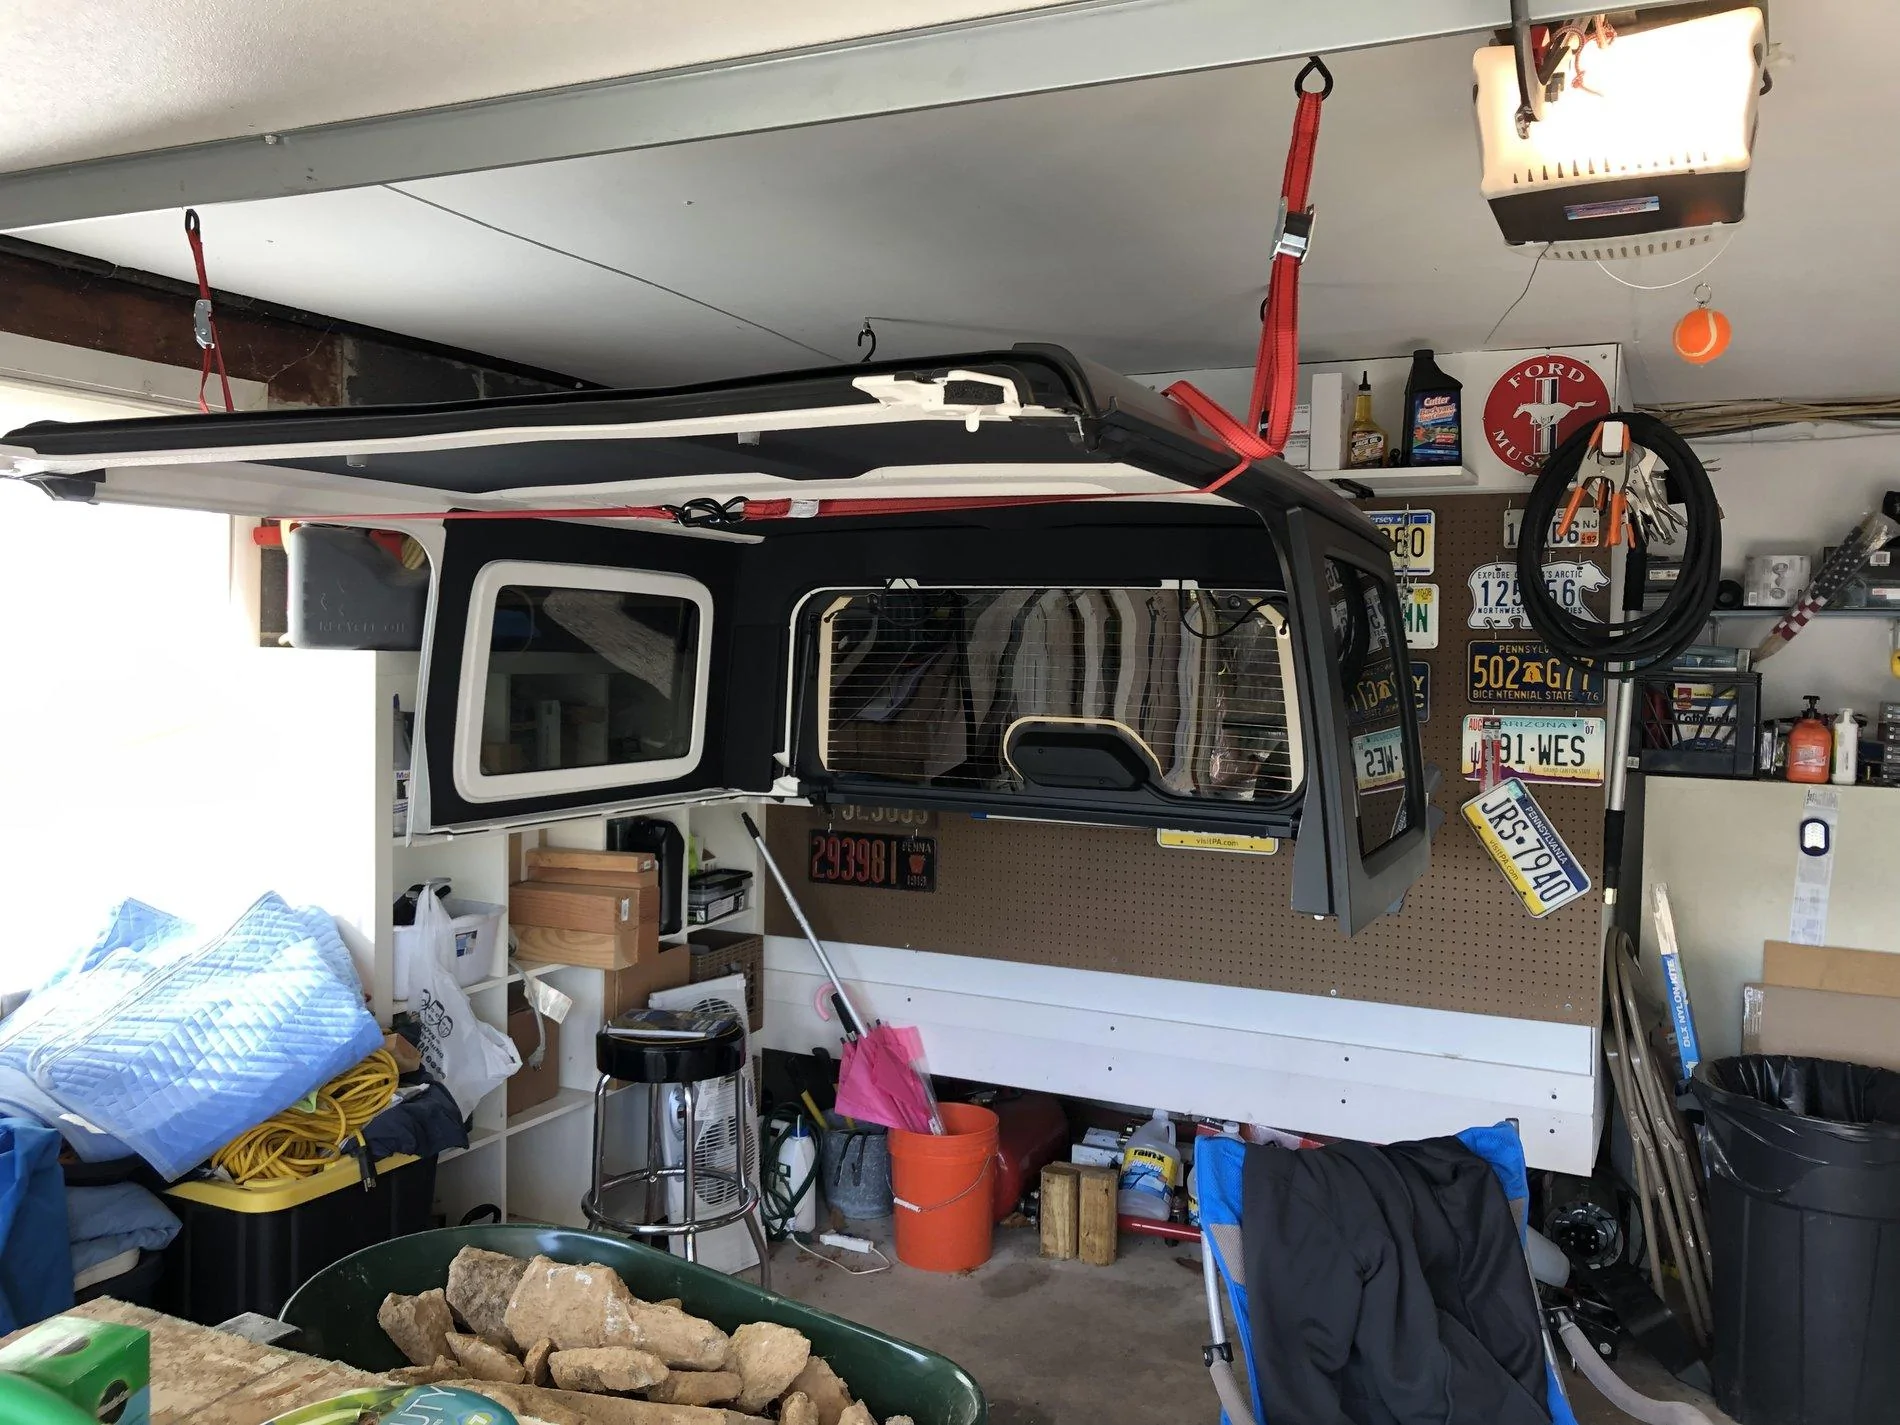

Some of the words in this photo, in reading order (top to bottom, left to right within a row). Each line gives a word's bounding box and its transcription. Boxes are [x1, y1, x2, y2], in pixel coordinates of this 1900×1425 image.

[1508, 362, 1585, 389] FORD
[1423, 396, 1450, 406] Cutter
[1492, 429, 1546, 469] MUS
[1582, 519, 1598, 529] NJ
[1586, 535, 1597, 543] 92
[1477, 571, 1510, 579] EXPLORE
[1554, 570, 1583, 578] ARCTIC
[1498, 644, 1549, 655] PENNSYLV
[1473, 655, 1520, 689] 502
[1472, 690, 1542, 700] BICENTENNIAL
[1546, 691, 1573, 701] STATE
[1500, 720, 1567, 729] ARIZONA
[1585, 725, 1595, 735] 07
[1195, 838, 1239, 847] visitPA.com
[1525, 806, 1569, 865] PENNSYLVANIA
[1481, 797, 1530, 841] JRS
[1512, 838, 1571, 902] 7940
[811, 836, 897, 885] 293981
[1489, 839, 1519, 881] visitPA.com
[1672, 986, 1687, 1024] NYLON
[1680, 1025, 1691, 1048] DLX
